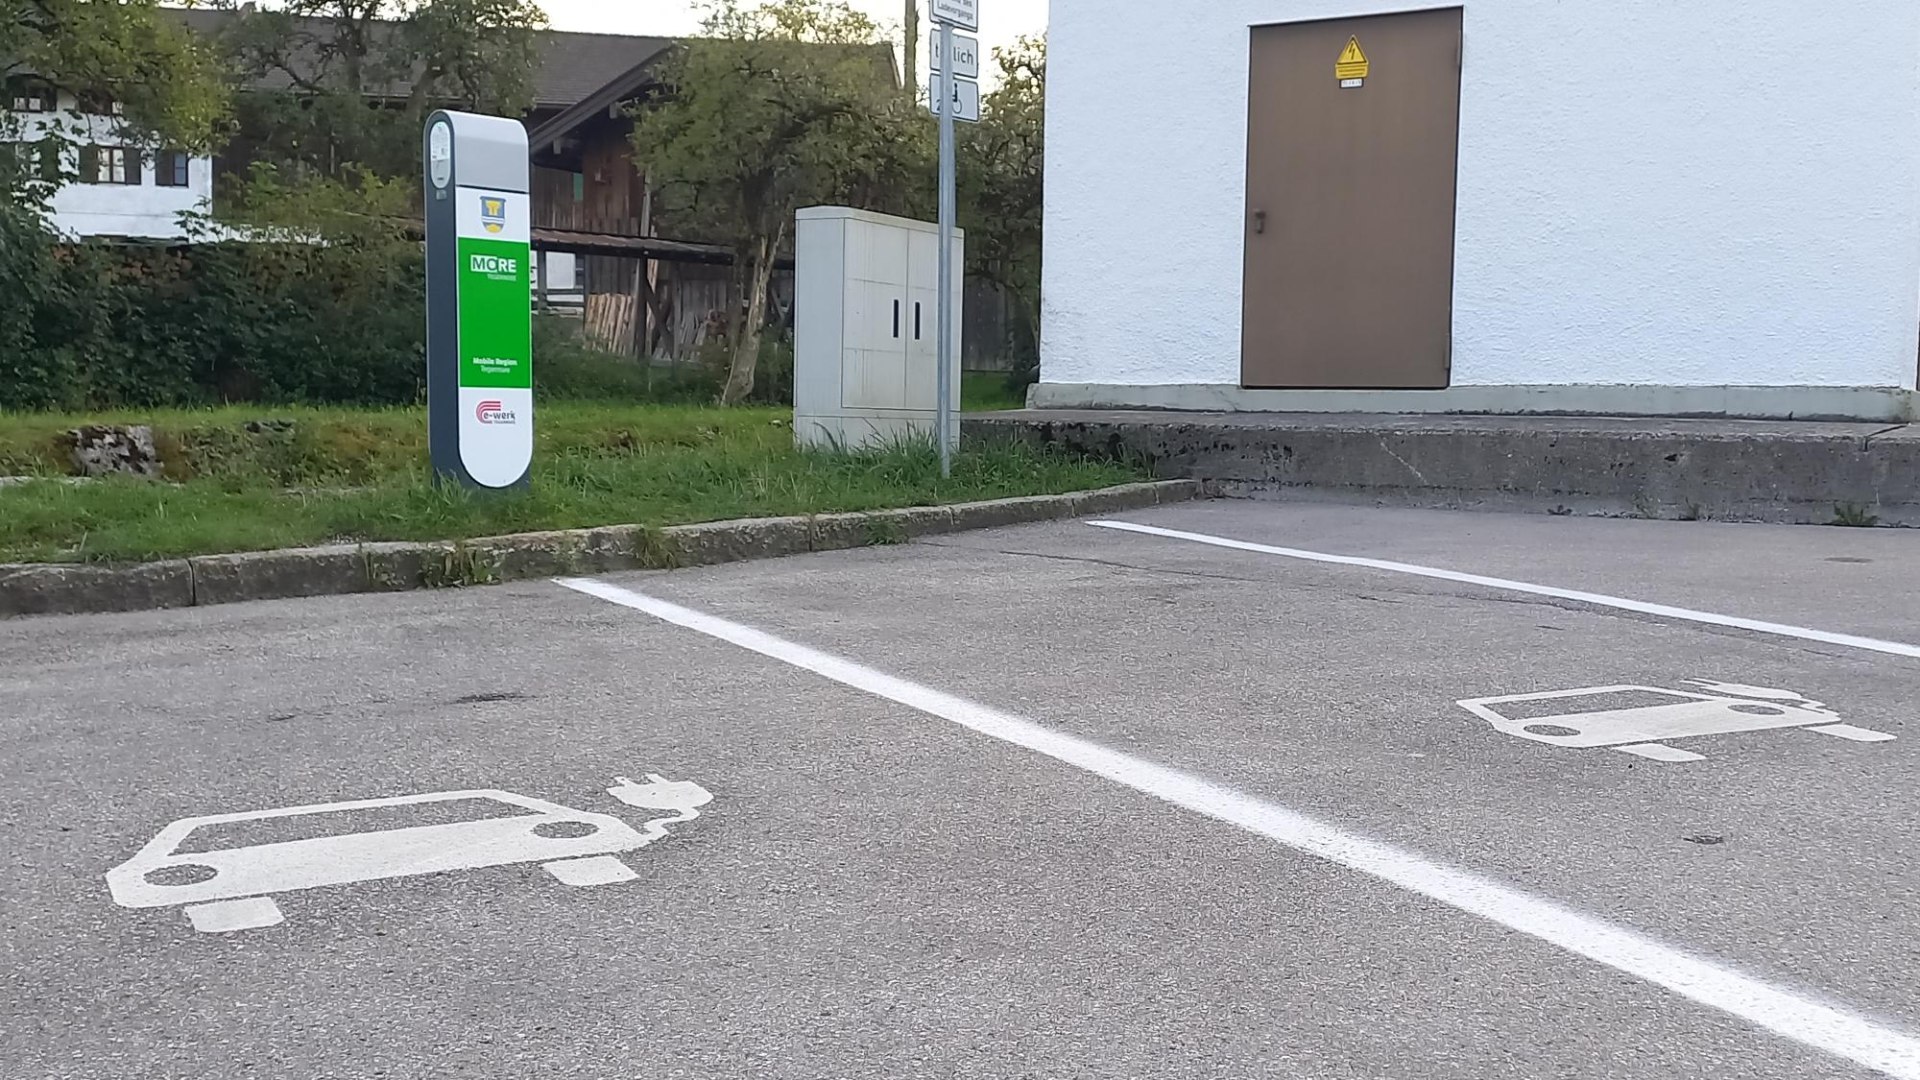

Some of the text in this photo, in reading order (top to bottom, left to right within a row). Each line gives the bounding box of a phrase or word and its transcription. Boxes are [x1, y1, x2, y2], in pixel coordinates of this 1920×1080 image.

[935, 42, 974, 66] tlich
[471, 255, 517, 273] MORE
[473, 357, 518, 367] Mobile Region
[483, 410, 516, 420] e-werk
